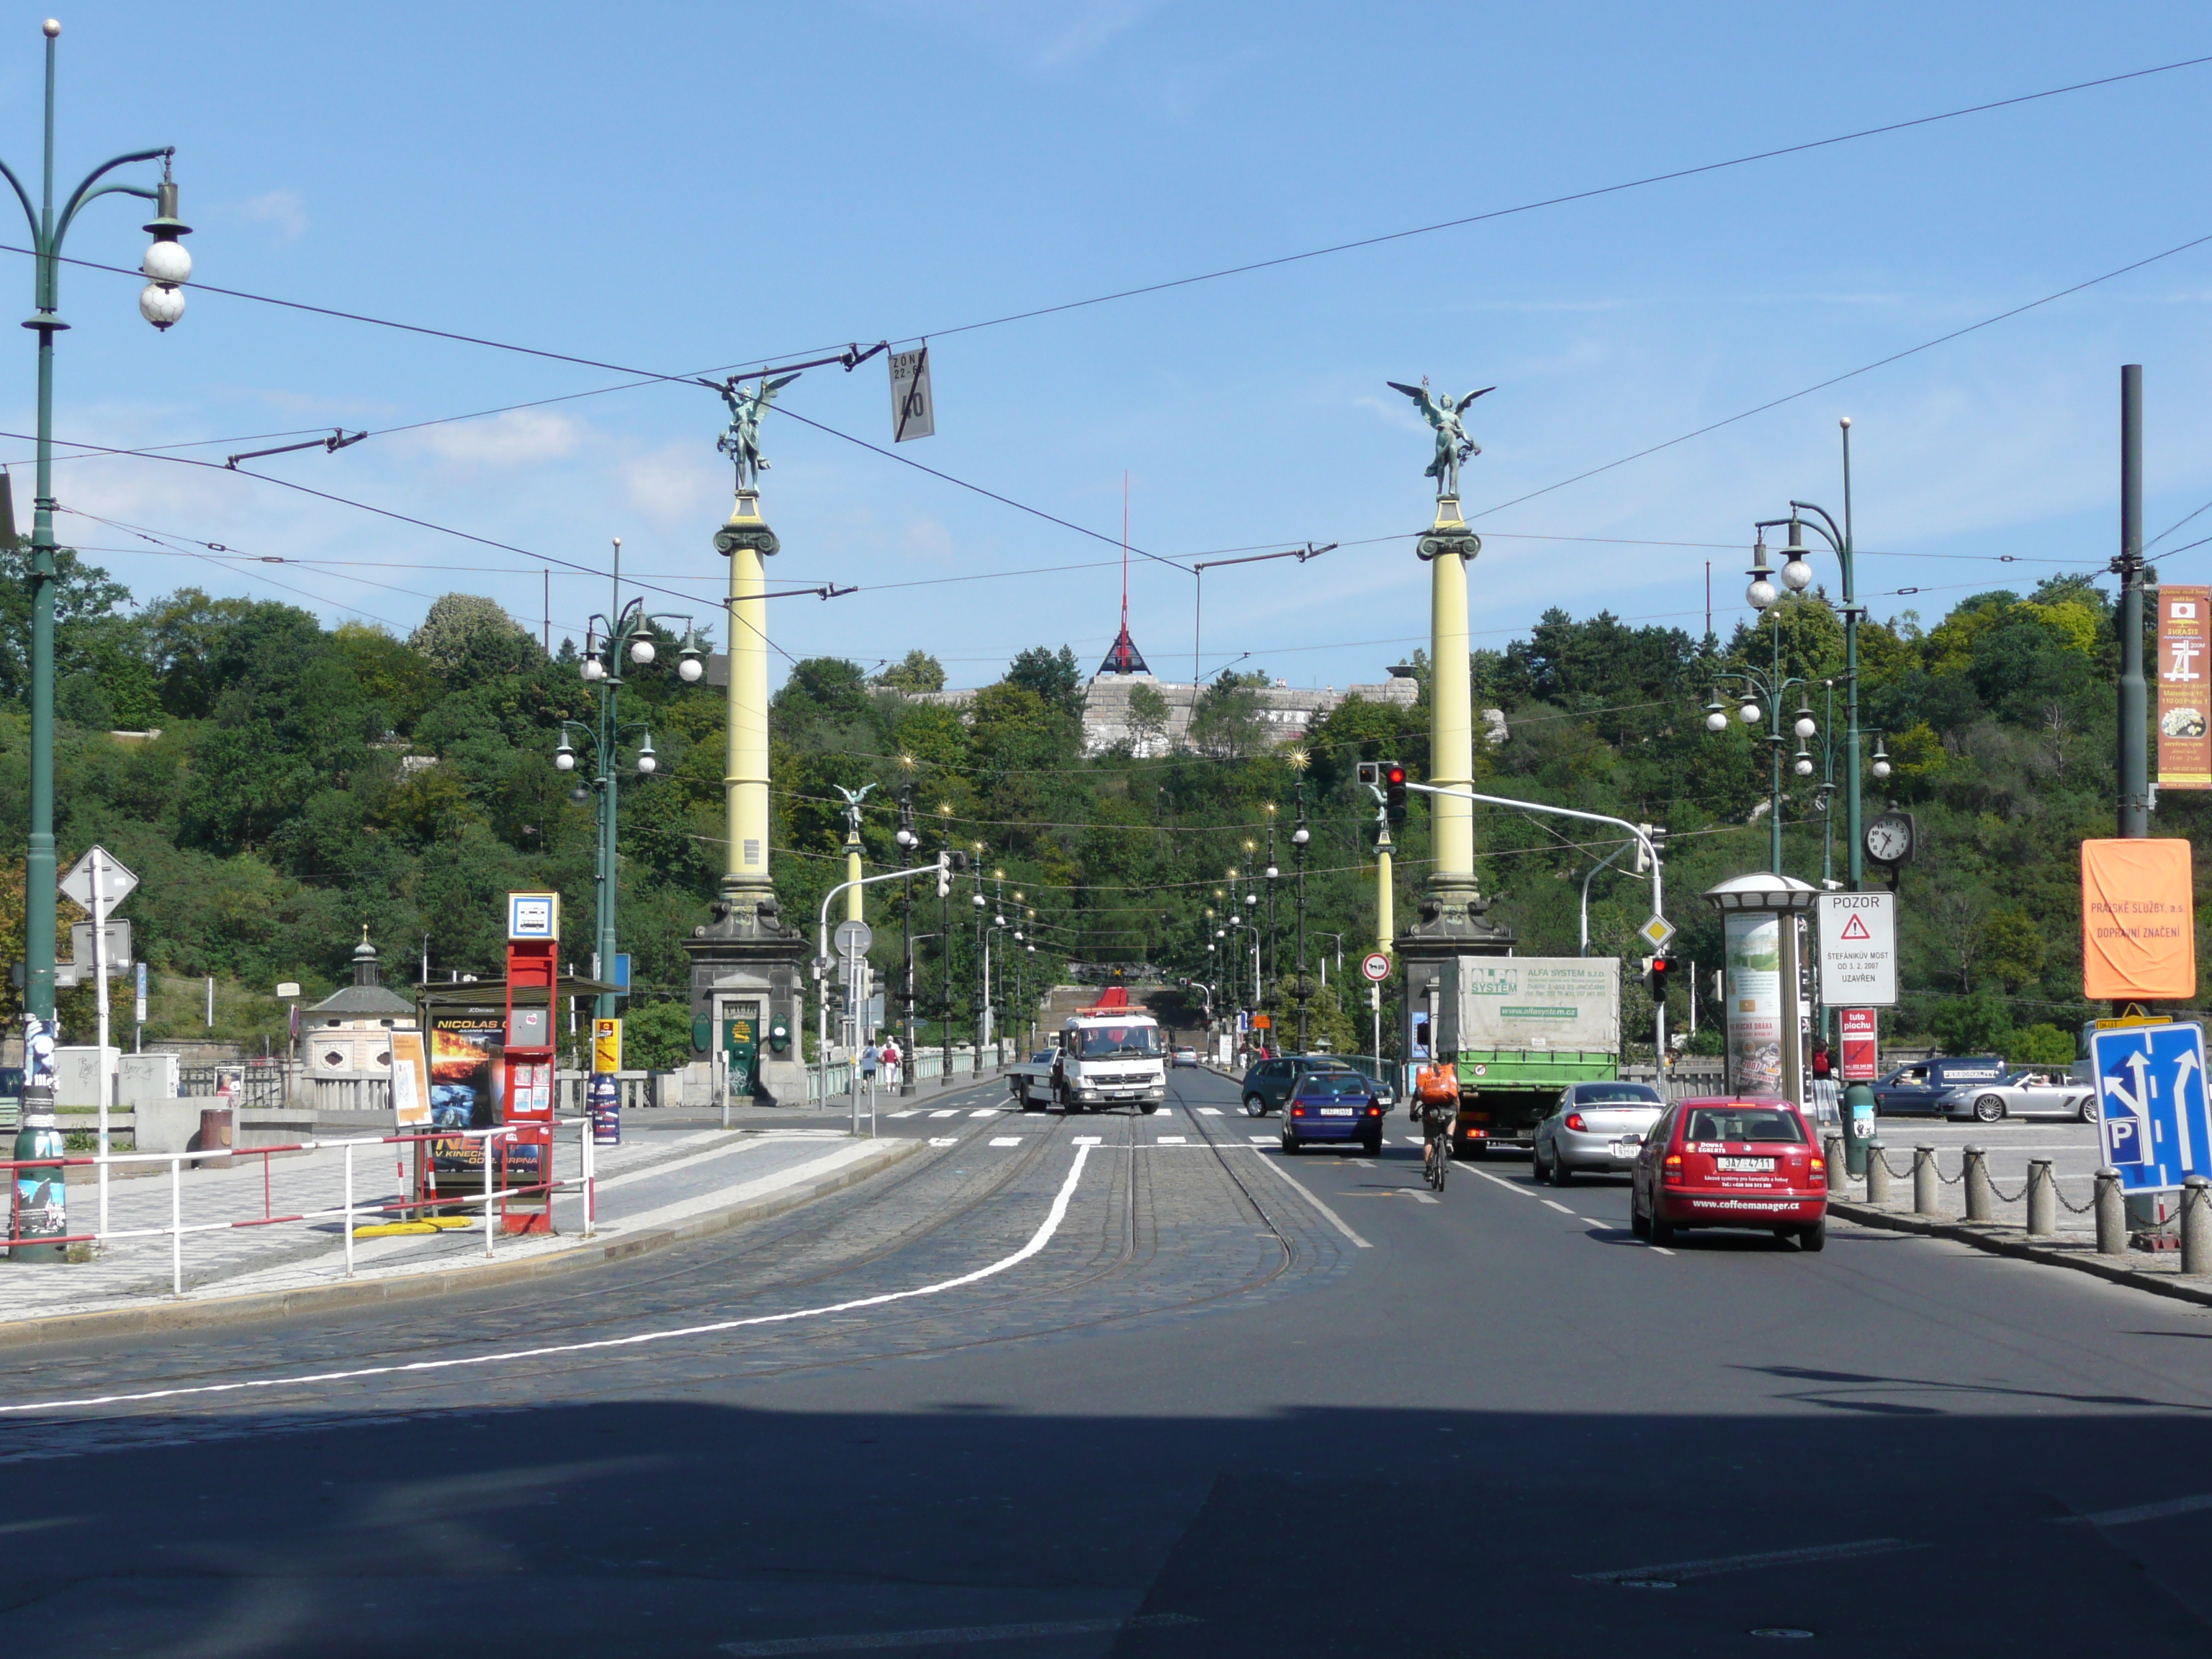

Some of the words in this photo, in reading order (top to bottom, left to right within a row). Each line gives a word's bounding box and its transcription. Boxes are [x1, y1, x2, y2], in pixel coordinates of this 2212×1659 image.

[902, 392, 925, 419] 40
[1833, 896, 1880, 909] POZOR
[2098, 925, 2141, 938] DOPRAVNÍ
[2143, 925, 2180, 938] ZNAČENÍ
[1842, 973, 1876, 982] UZAVŘEN
[1471, 984, 1517, 993] SYSTEM
[1501, 1008, 1576, 1017] www.alfasystem.cz
[1844, 1021, 1871, 1030] plochu
[2111, 1123, 2133, 1148] P
[1725, 1159, 1740, 1168] 3A7
[1748, 1159, 1770, 1168] 4711
[1692, 1200, 1799, 1212] www.coffeemanager.cz
